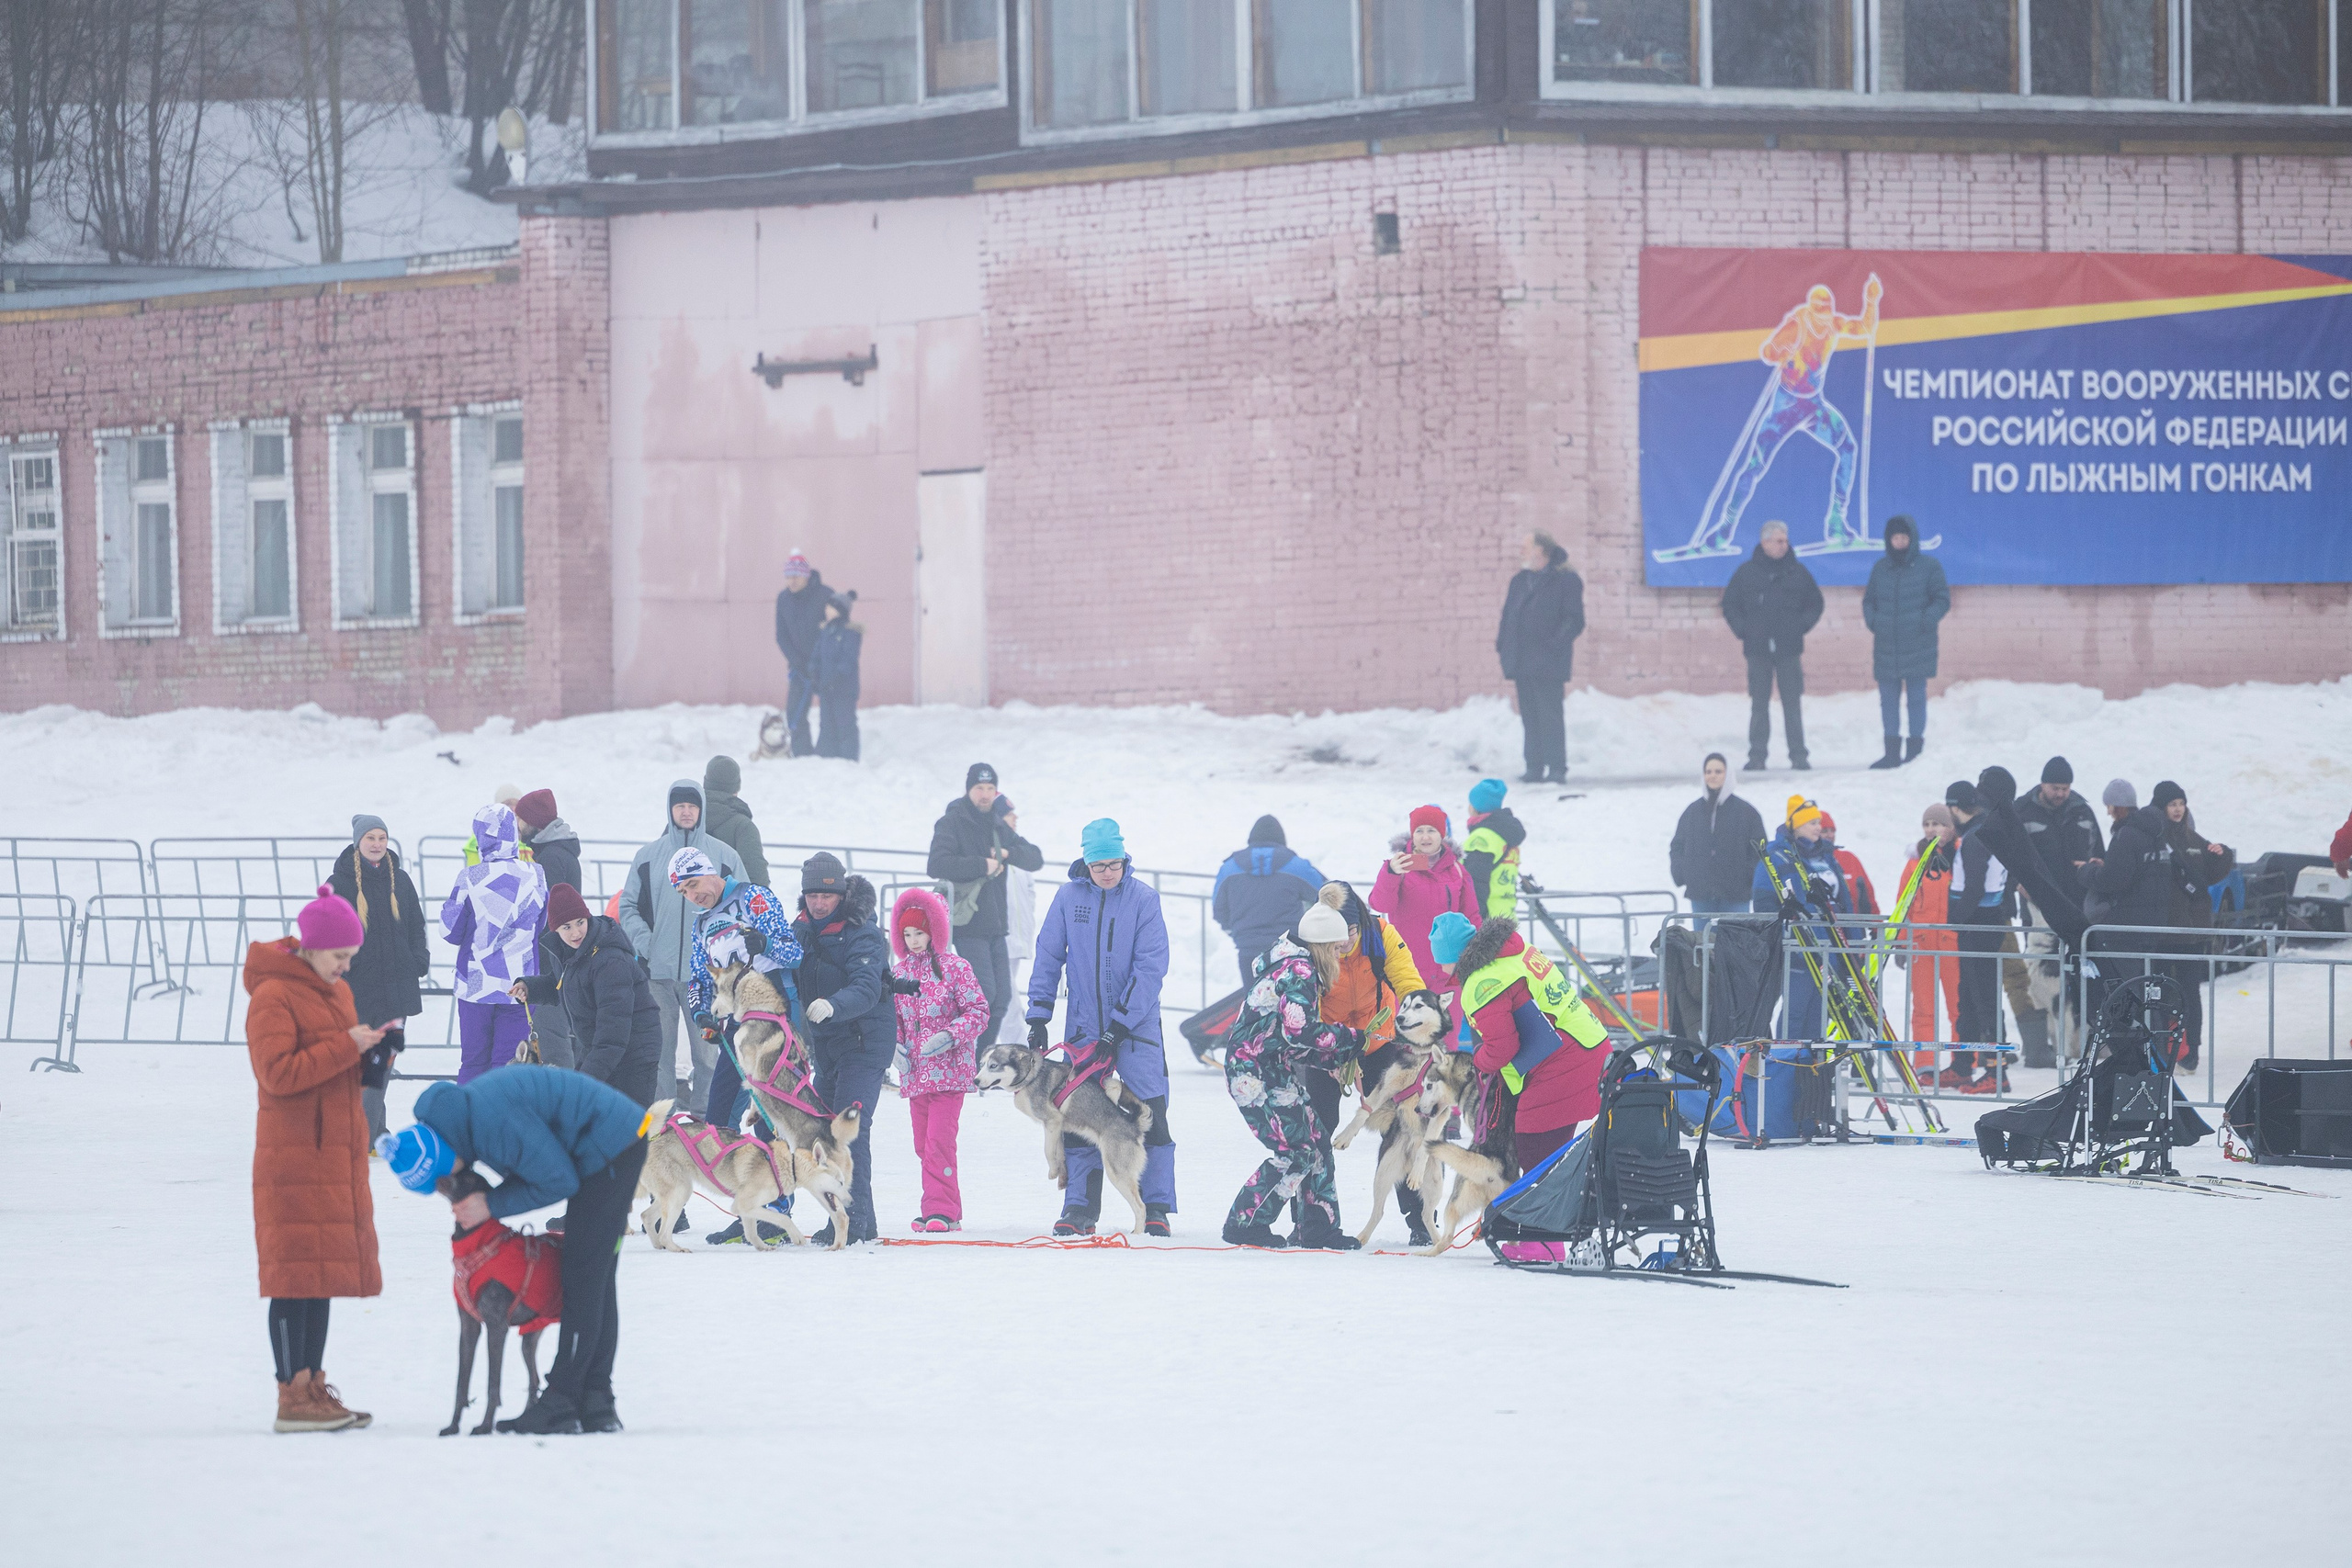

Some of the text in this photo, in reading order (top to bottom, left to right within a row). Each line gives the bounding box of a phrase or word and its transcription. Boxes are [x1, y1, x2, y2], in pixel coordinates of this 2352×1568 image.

[1883, 369, 2352, 400] ЧЕМПИОНАТ ВООРУЖЕННЫХ С
[1932, 408, 2347, 449] РОССИЙСКОЙ ФЕДЕРАЦИИ
[1972, 462, 2312, 493] ПО ЛЫЖНЫМ ГОНКАМ
